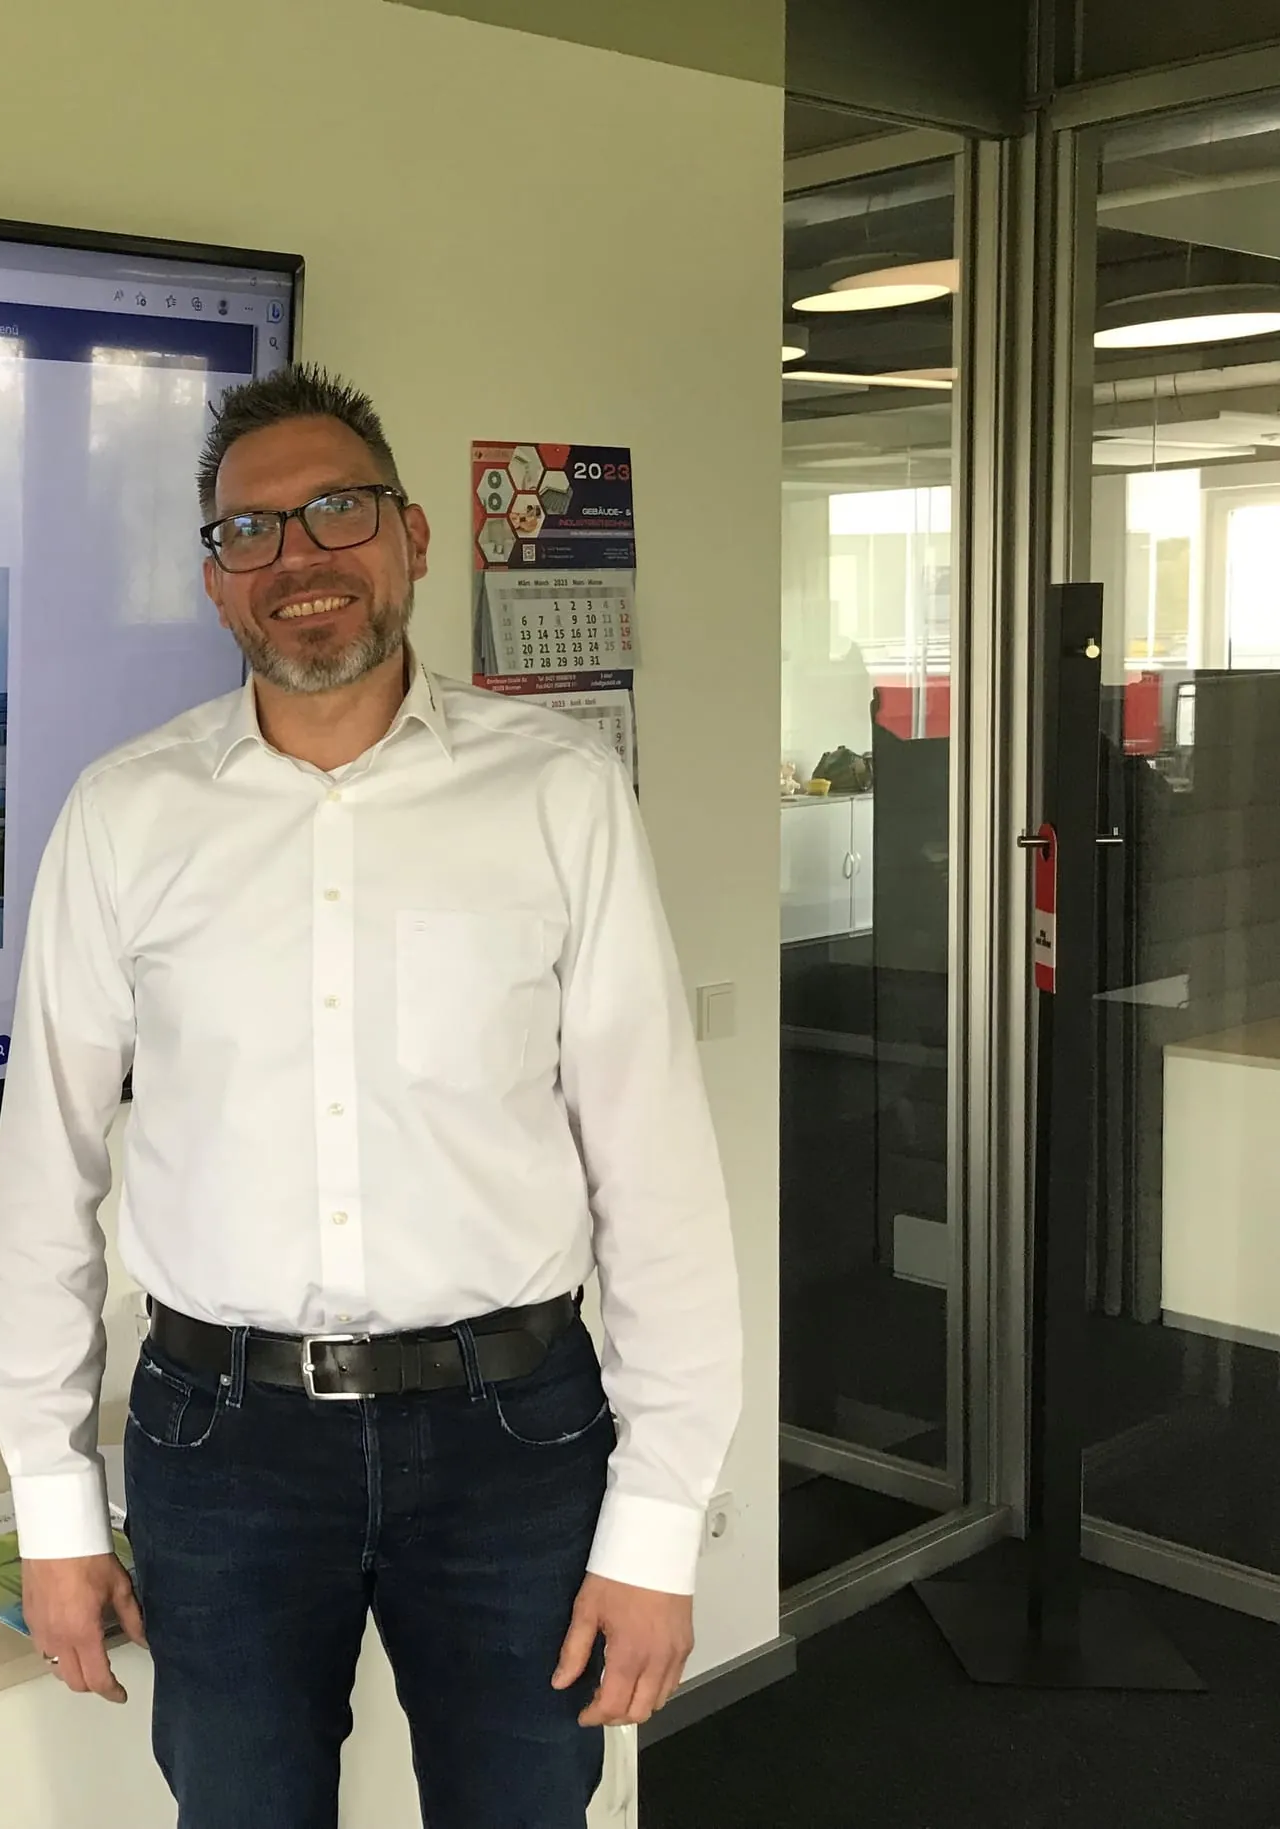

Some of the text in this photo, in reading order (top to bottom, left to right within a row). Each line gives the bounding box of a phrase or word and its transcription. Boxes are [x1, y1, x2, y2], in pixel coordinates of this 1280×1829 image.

[574, 462, 629, 480] 2023
[554, 602, 559, 611] 1
[571, 601, 576, 610] 2
[587, 601, 592, 610] 3
[620, 601, 625, 609] 5
[522, 616, 527, 625] 6
[539, 616, 544, 625] 7
[572, 615, 577, 624] 9
[586, 615, 596, 624] 10
[620, 614, 629, 623] 12
[521, 631, 531, 640] 13
[538, 630, 548, 639] 14
[555, 630, 565, 639] 15
[571, 629, 581, 638] 16
[588, 629, 597, 638] 17
[621, 628, 630, 637] 19
[523, 645, 533, 654] 20
[539, 644, 550, 653] 21
[556, 644, 566, 653] 22
[572, 643, 582, 652] 23
[589, 642, 599, 651] 24
[622, 641, 631, 650] 26
[524, 659, 534, 668] 27
[541, 658, 551, 668] 28
[557, 658, 568, 667] 29
[574, 657, 584, 666] 30
[590, 656, 600, 665] 31
[599, 719, 621, 729] 1 2
[616, 733, 621, 741] 9
